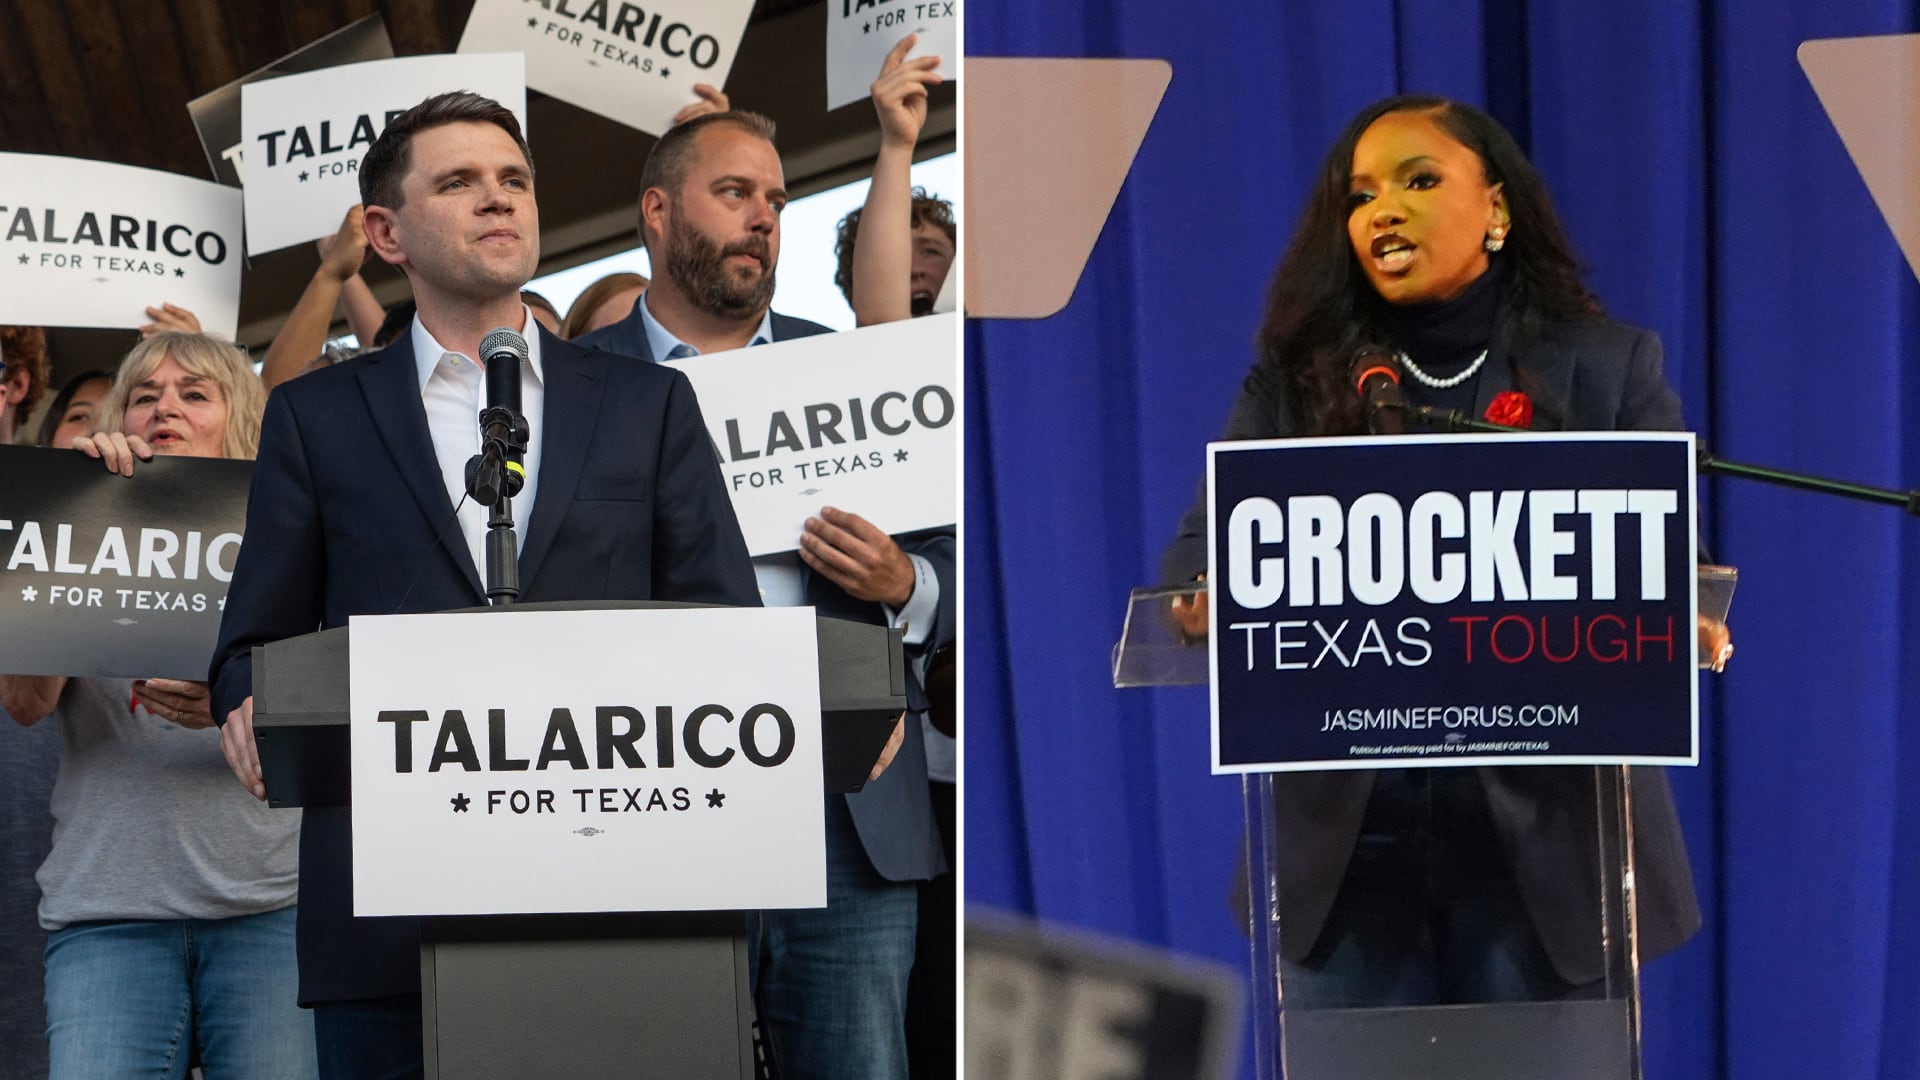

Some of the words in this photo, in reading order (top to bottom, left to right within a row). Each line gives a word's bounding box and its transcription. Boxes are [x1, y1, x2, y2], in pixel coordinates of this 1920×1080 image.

[521, 0, 720, 69] LARICO
[875, 8, 905, 32] FOR
[545, 22, 583, 47] FOR
[592, 38, 653, 73] TEXAS
[319, 159, 358, 178] FOR
[0, 206, 227, 266] ALARICO
[41, 253, 82, 269] FOR
[93, 256, 165, 276] TEXAS
[710, 385, 955, 464] LARICO
[733, 468, 784, 491] FOR
[794, 451, 883, 480] TEXAS
[1228, 489, 1678, 609] CROCKETT
[50, 586, 103, 607] FOR
[116, 589, 207, 612] TEXAS
[1229, 617, 1433, 671] TEXAS
[1448, 614, 1675, 664] TOUGH
[377, 703, 796, 773] TALARICO
[1320, 704, 1580, 733] JASMINEFORUS.COM
[1456, 743, 1467, 754] by
[487, 789, 556, 814] FOR
[572, 787, 691, 813] TEXAS
